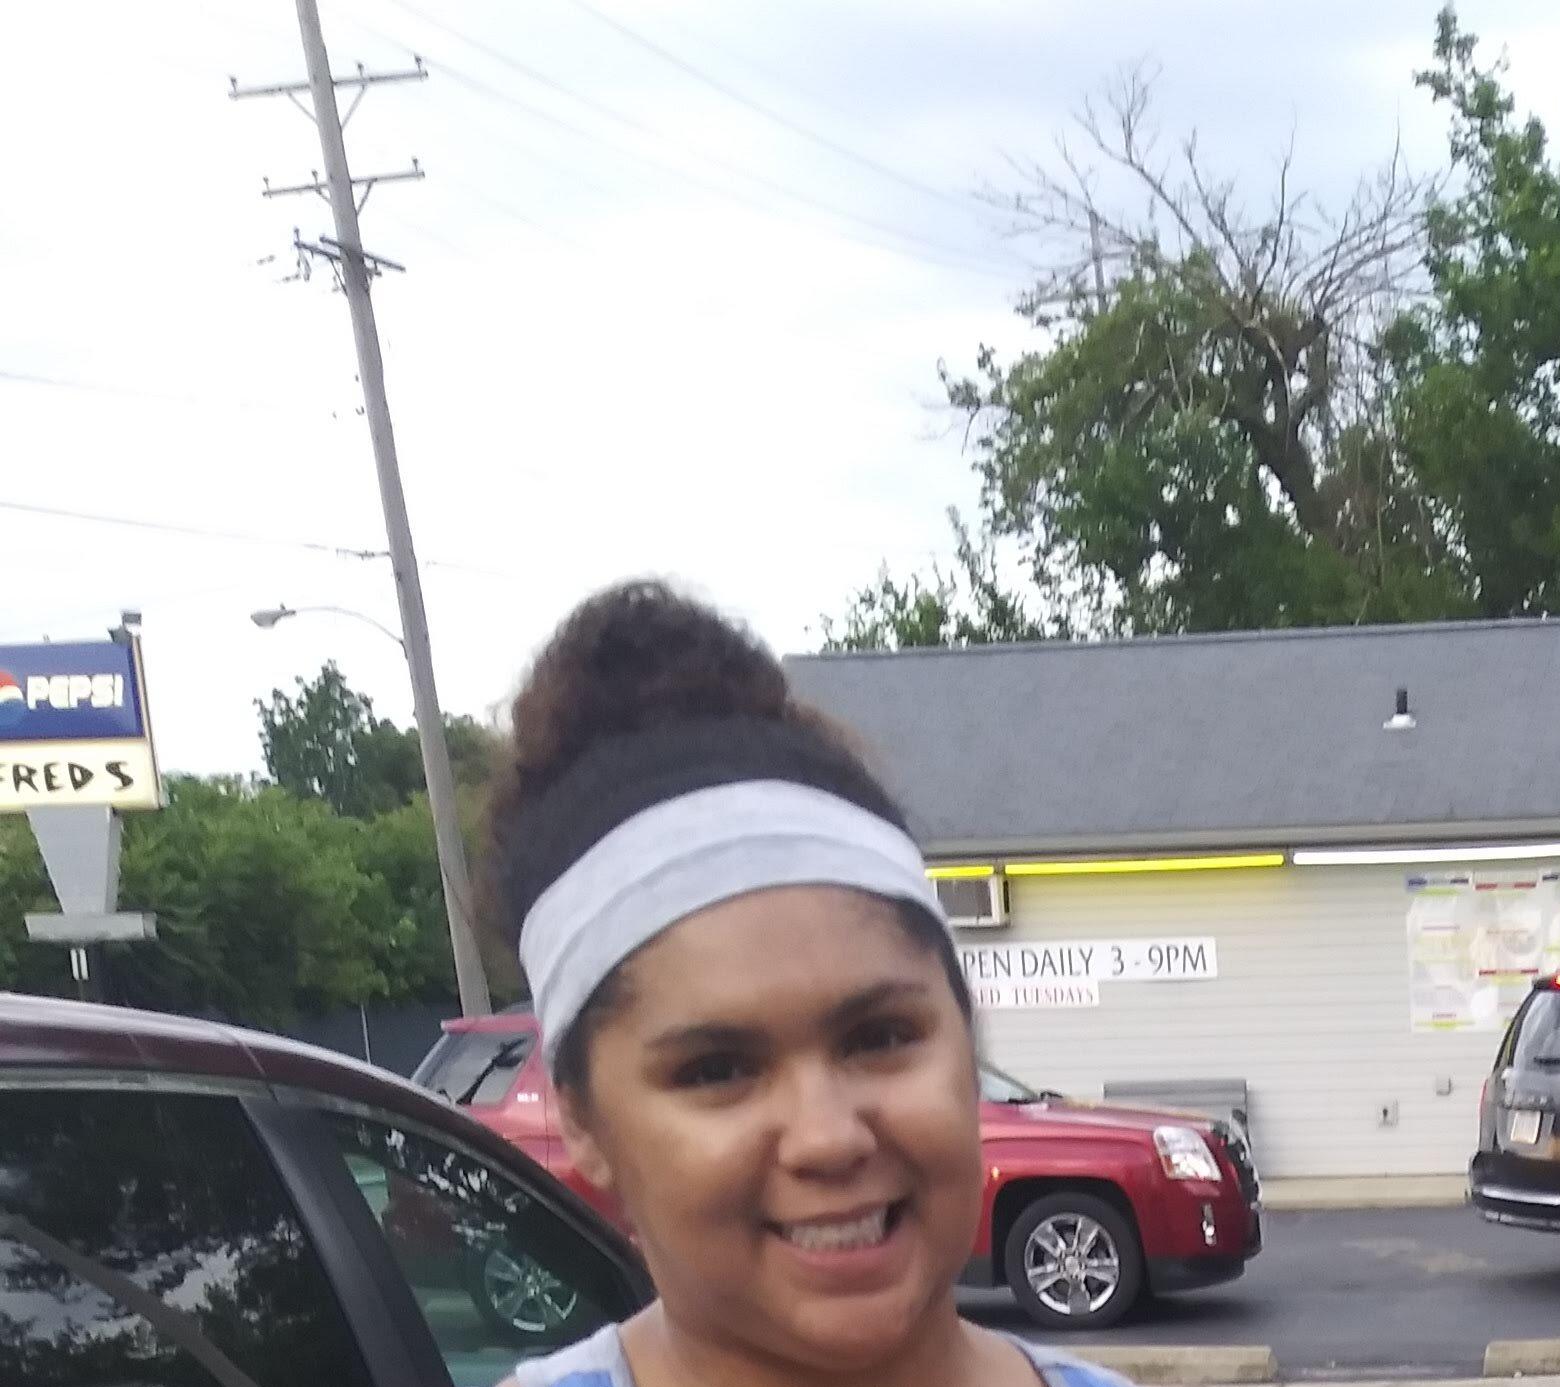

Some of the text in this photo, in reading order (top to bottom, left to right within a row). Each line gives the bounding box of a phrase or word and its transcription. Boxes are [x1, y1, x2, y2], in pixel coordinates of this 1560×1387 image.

[27, 674, 124, 710] PEPSI
[961, 949, 1011, 978] PEN
[1020, 947, 1094, 977] DAILY
[1110, 945, 1125, 976] 3
[1147, 943, 1207, 975] 9PM
